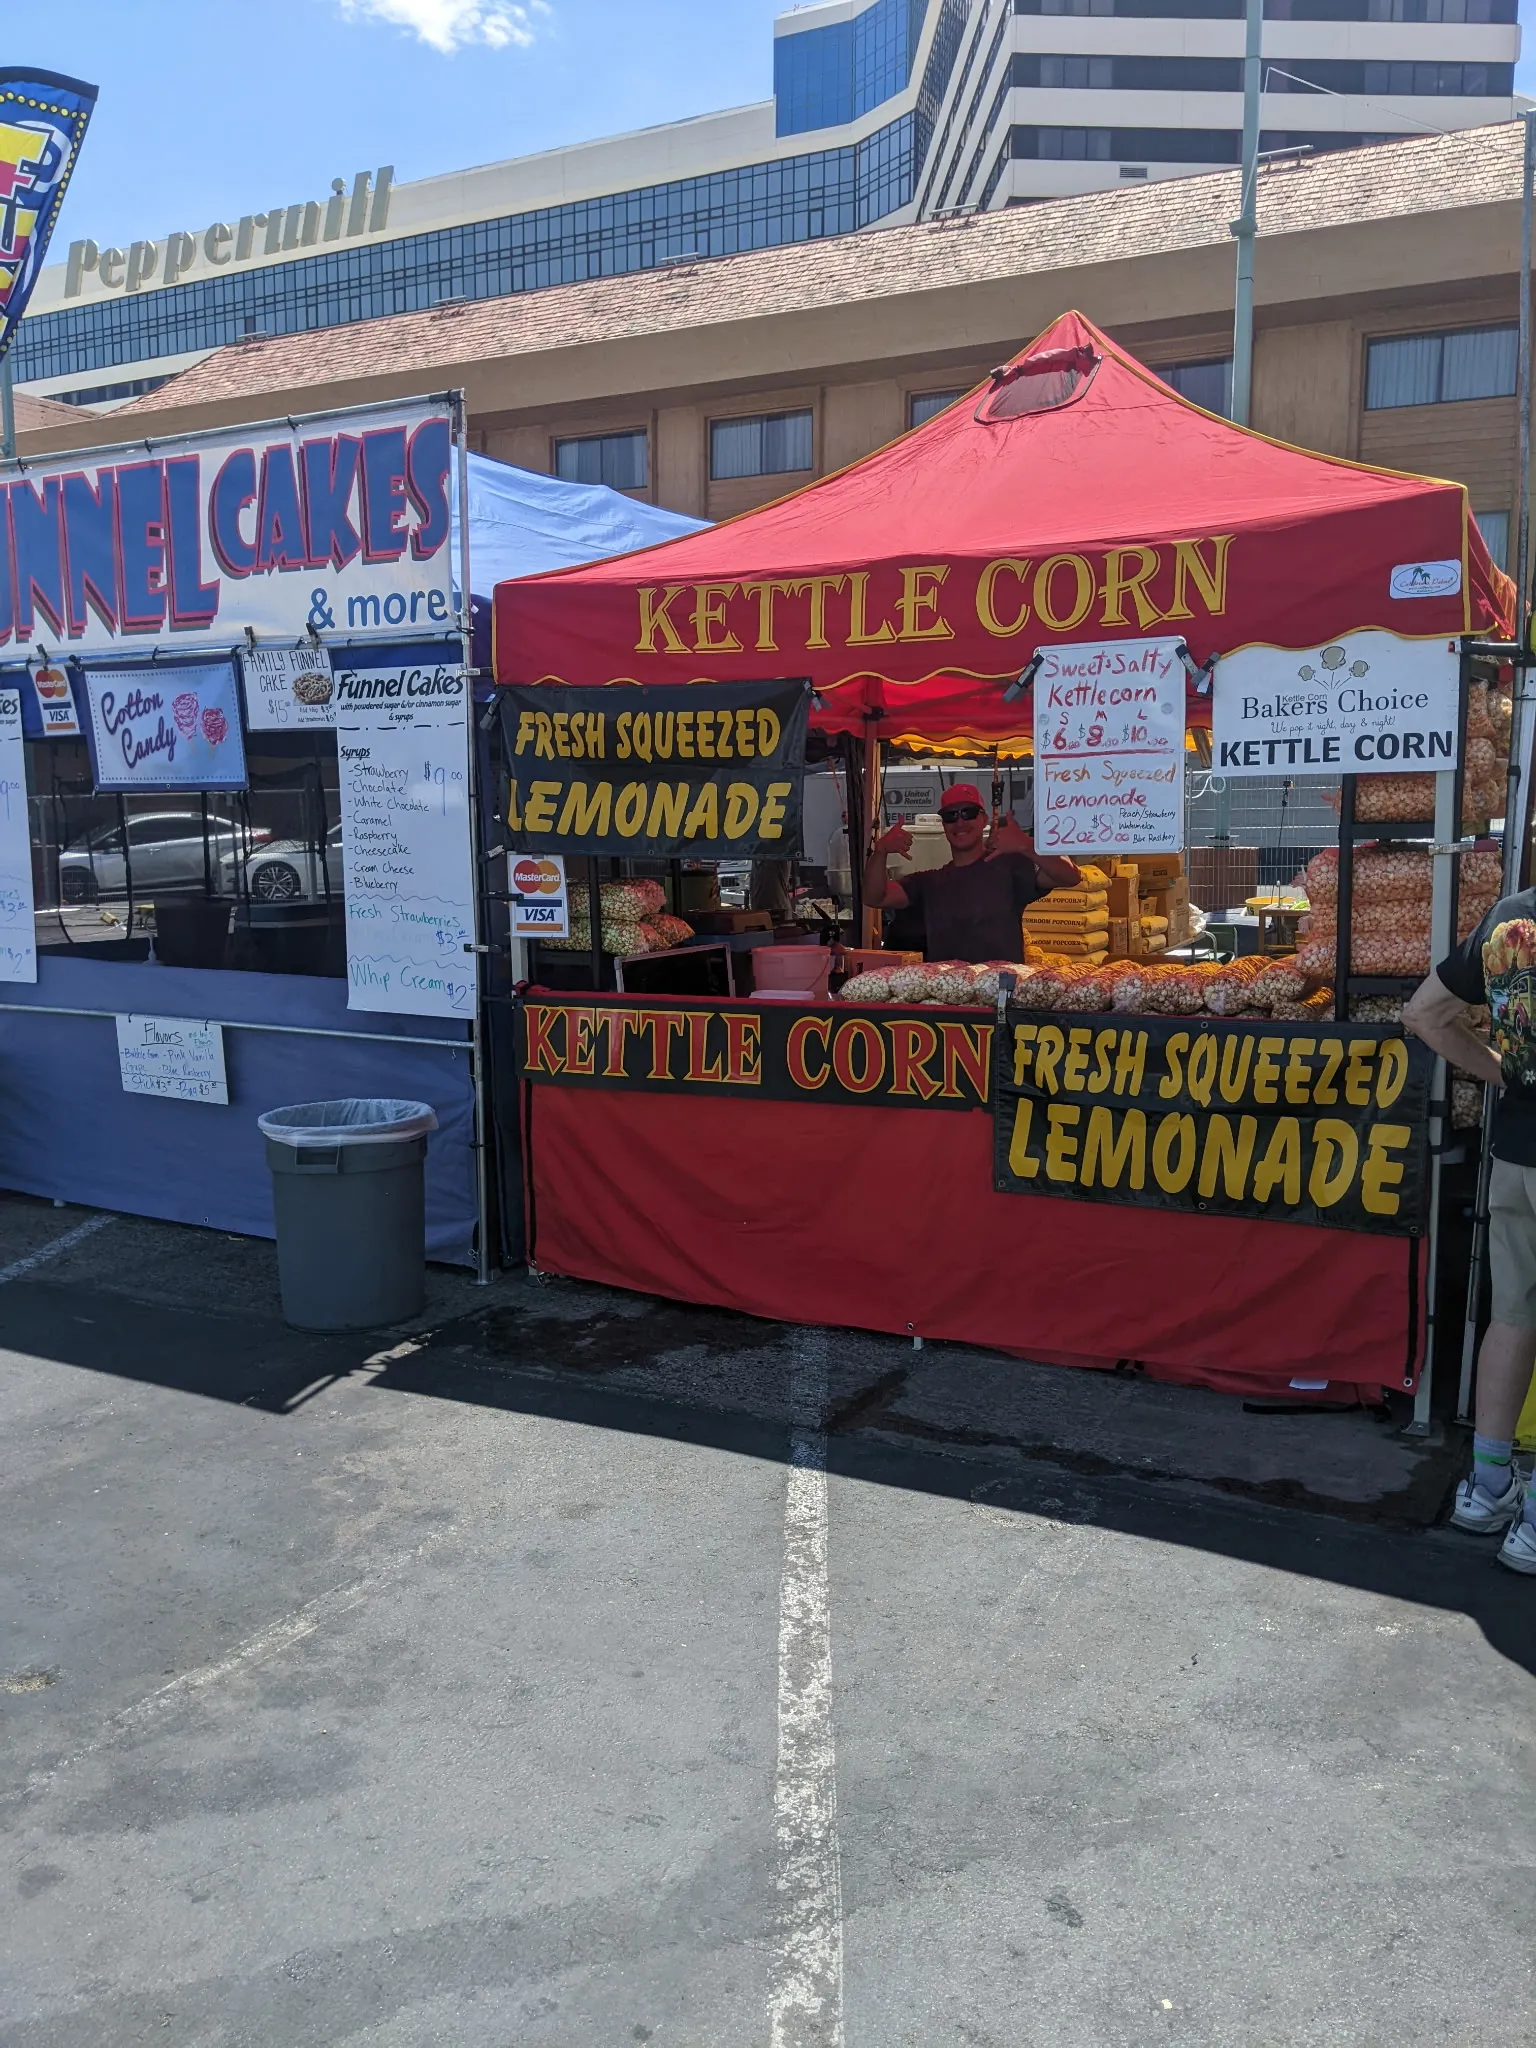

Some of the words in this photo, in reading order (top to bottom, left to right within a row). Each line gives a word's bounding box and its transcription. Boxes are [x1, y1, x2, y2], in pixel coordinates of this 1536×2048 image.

[65, 165, 394, 298] Peppermill
[0, 454, 220, 648] NNEL
[209, 417, 450, 579] CAKES
[635, 564, 955, 654] KETTLE
[976, 533, 1236, 637] CORN
[308, 588, 335, 629] &
[347, 588, 448, 628] more
[243, 652, 286, 672] FAMILY
[289, 651, 328, 671] FUNNEL
[1044, 651, 1104, 678] Sweet
[1112, 648, 1173, 679] Salty
[37, 678, 66, 689] MasterCard
[260, 674, 287, 692] CAKE
[337, 670, 406, 700] Funnel
[407, 667, 464, 696] Cakes
[341, 703, 353, 711] with
[354, 701, 384, 712] powdered
[384, 703, 400, 711] sugar
[415, 700, 444, 708] cinnamon
[445, 699, 461, 709] sugar
[1241, 695, 1328, 719] Bakers
[1338, 688, 1428, 713] Choice
[1282, 694, 1305, 703] Kettle
[1307, 693, 1328, 702] Corn
[50, 710, 69, 722] VISA
[101, 688, 163, 735] Cotton
[395, 713, 413, 723] syrups
[1060, 711, 1069, 725] S
[1095, 710, 1108, 722] M
[1137, 709, 1148, 720] L
[514, 710, 605, 761] FRESH
[616, 708, 781, 763] SQUEEZED
[1271, 721, 1287, 734] We
[1289, 724, 1304, 736] pop
[1307, 722, 1315, 731] it
[1340, 717, 1356, 734] day
[1361, 717, 1368, 727] &
[1371, 716, 1396, 732] night!
[121, 716, 176, 769] Candy
[340, 745, 370, 761] Syrups
[1220, 736, 1340, 767] KETTLE
[1354, 731, 1453, 761] CORN
[1044, 762, 1091, 783] Fresh
[1102, 760, 1176, 787] Squeezed
[387, 798, 430, 812] Chocolate
[904, 789, 930, 797] United
[1046, 787, 1147, 811] Lemonade
[507, 779, 793, 839] LEMONADE
[383, 861, 414, 874] Cheese
[515, 872, 560, 882] MasterCard
[349, 903, 382, 919] Fresh
[390, 905, 460, 928] Strawberries
[524, 908, 555, 921] VISA
[350, 964, 390, 992] Whip
[401, 966, 446, 991] Cream
[144, 1022, 183, 1044] Flavors
[522, 1004, 763, 1086] KETTLE
[785, 1018, 993, 1103] CORN
[1014, 1025, 1146, 1096] FRESH
[1159, 1030, 1409, 1110] SQUEEZED
[1009, 1098, 1411, 1215] LEMONADE
